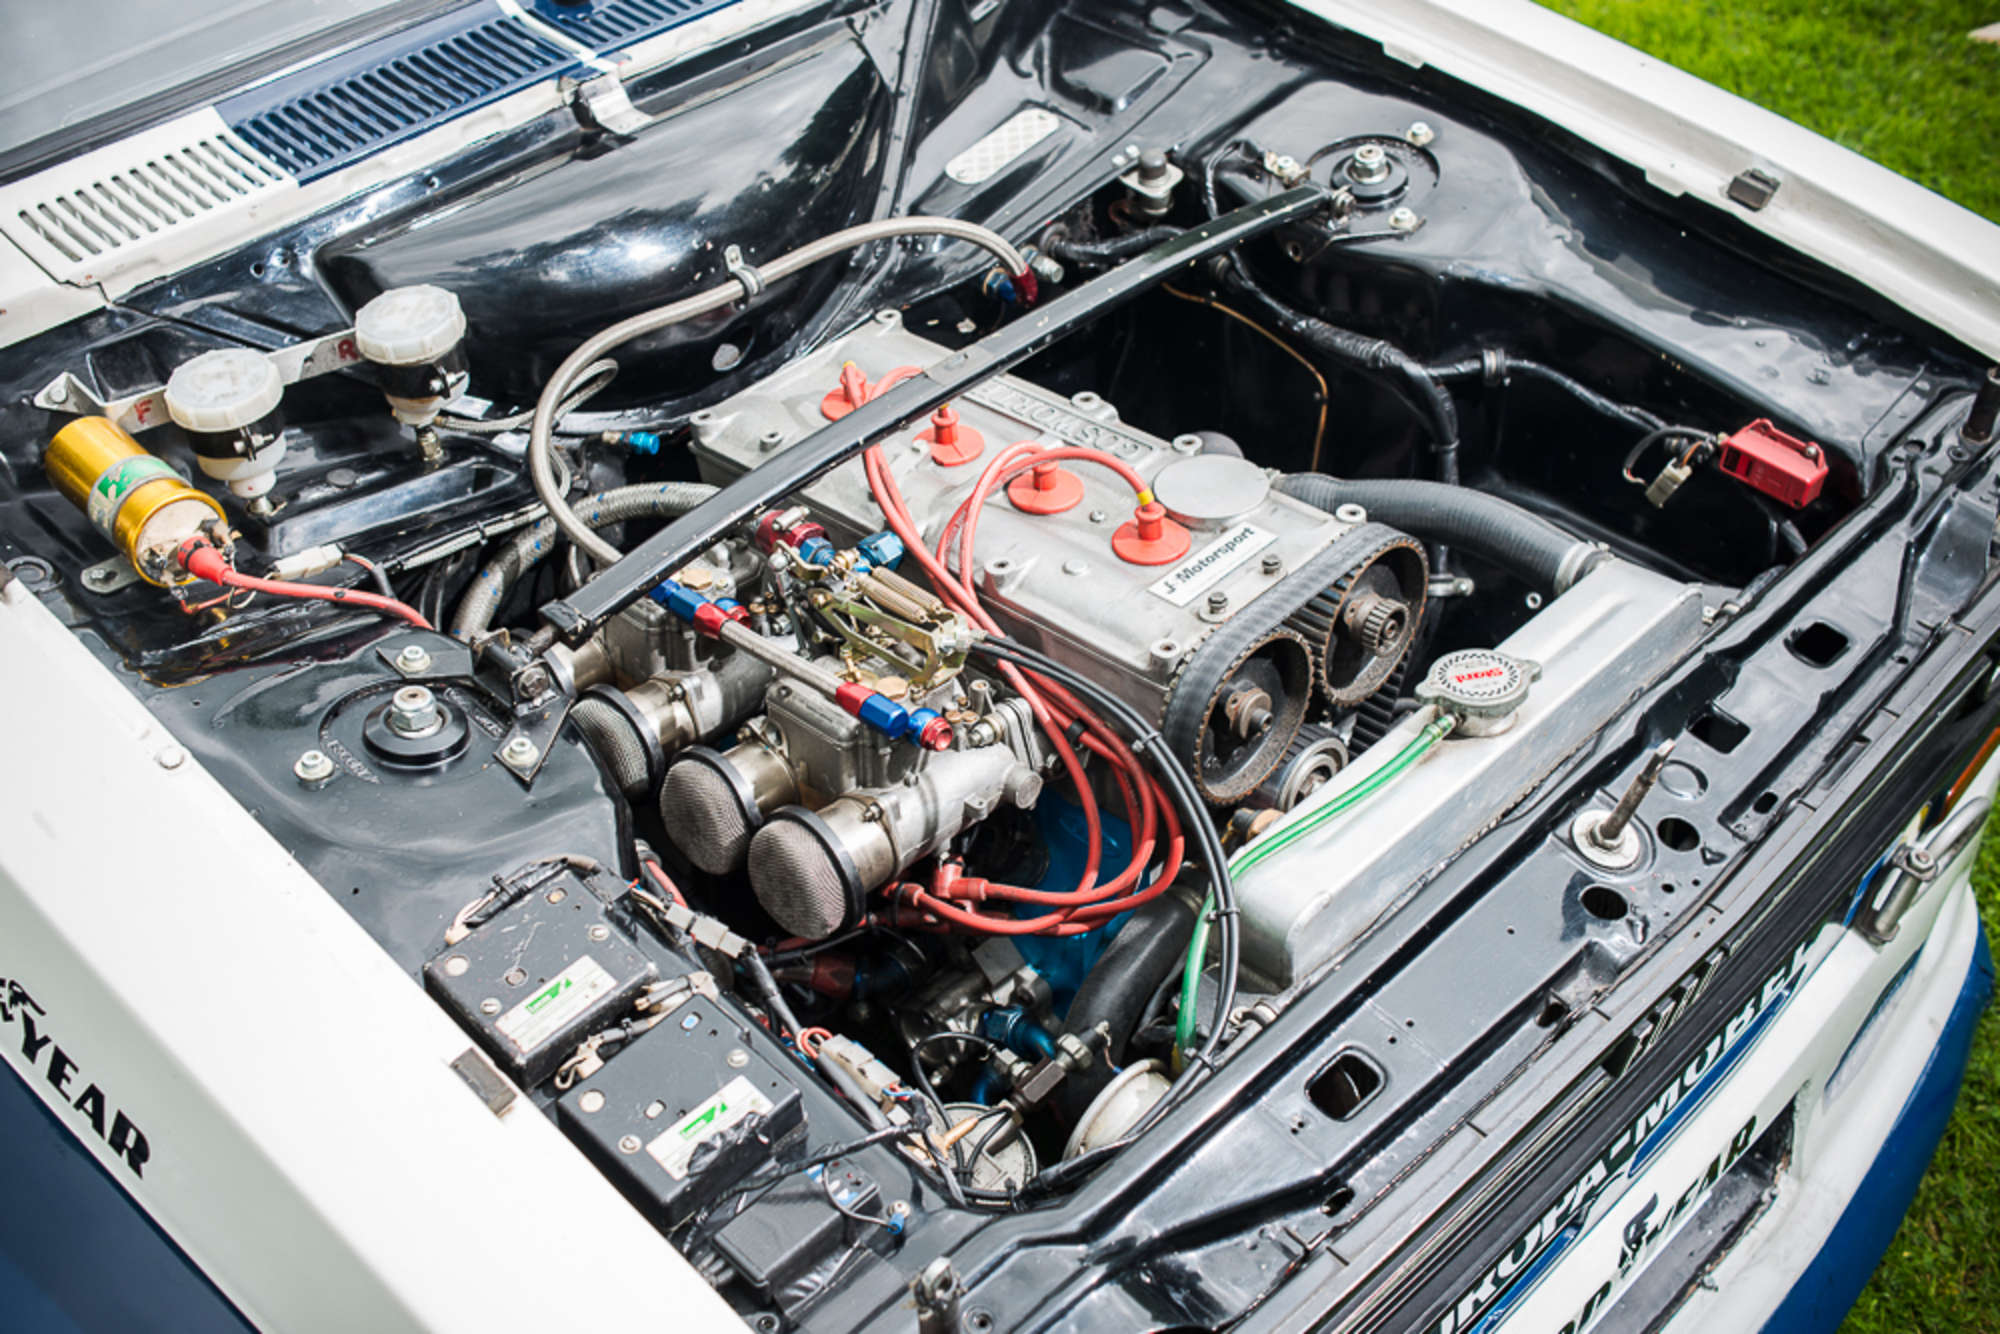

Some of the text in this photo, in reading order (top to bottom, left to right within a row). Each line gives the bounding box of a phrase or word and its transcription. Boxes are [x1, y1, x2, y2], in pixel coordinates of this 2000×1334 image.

[339, 341, 359, 361] R
[135, 400, 153, 424] F
[1175, 527, 1255, 583] Motorsport
[22, 1008, 151, 1180] YEAR
